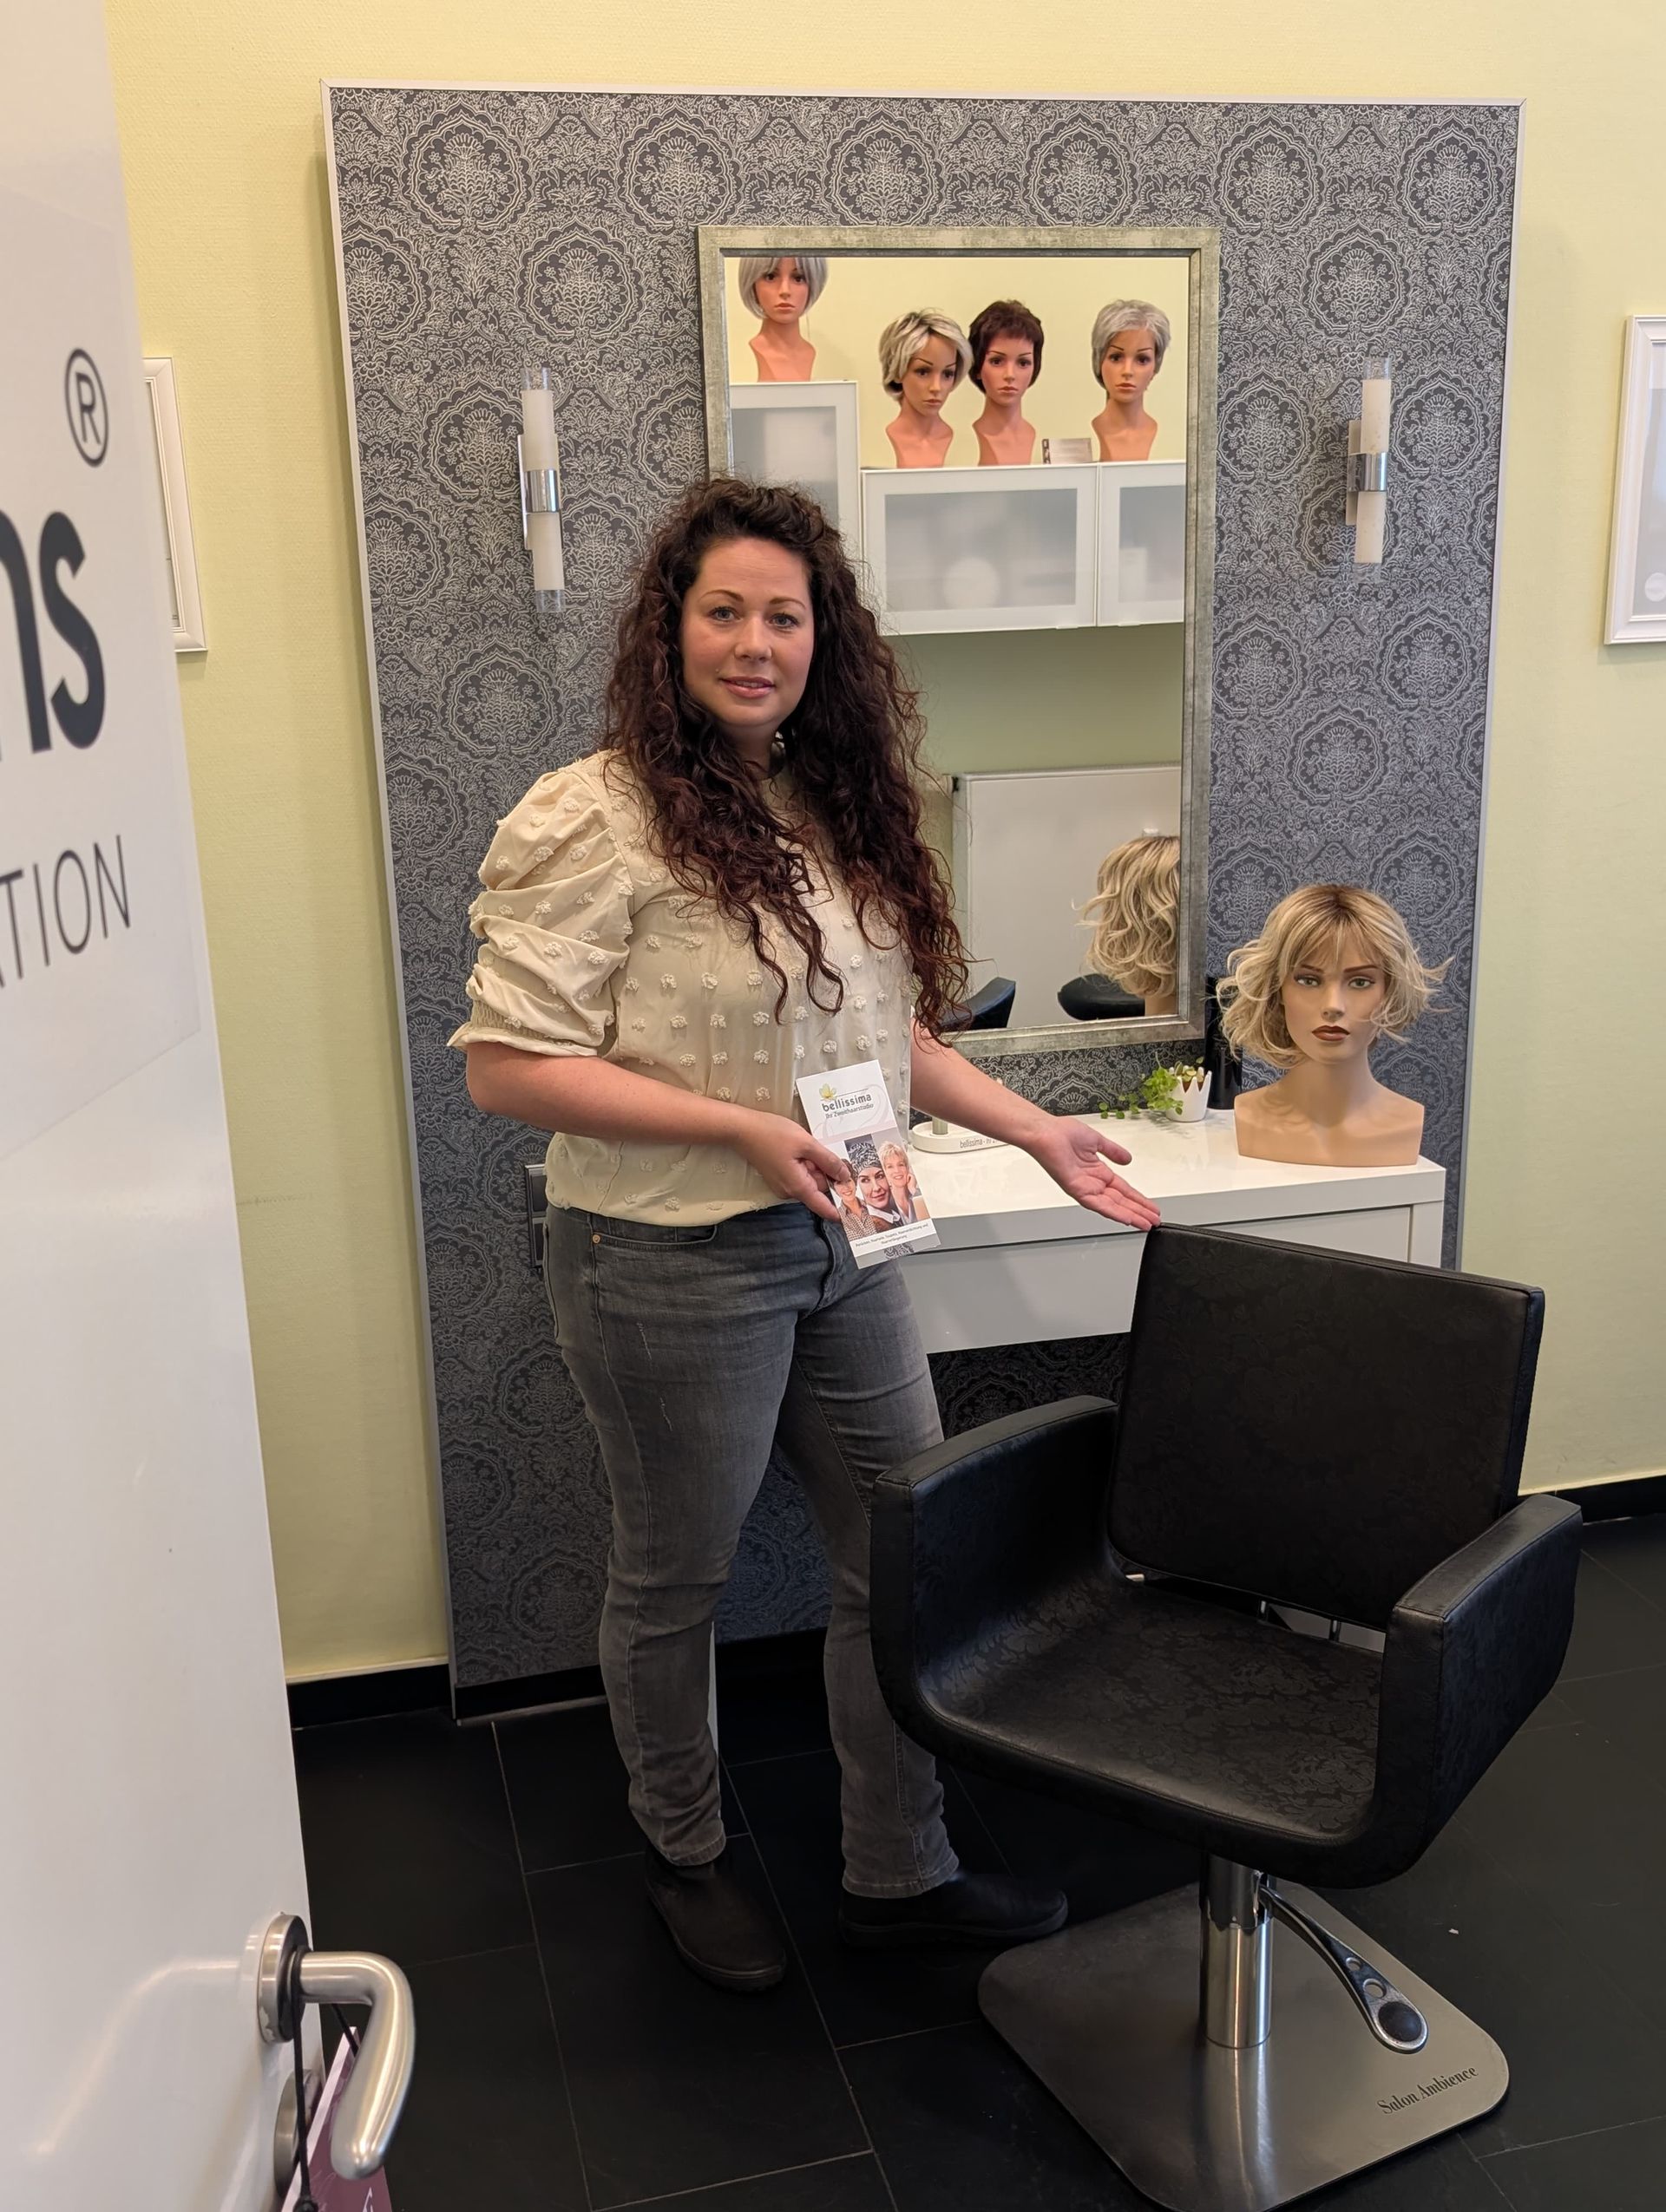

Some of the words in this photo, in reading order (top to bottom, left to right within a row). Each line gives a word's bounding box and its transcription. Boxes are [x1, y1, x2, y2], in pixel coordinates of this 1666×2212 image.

[0, 834, 131, 988] TION
[821, 1094, 872, 1112] bellissima
[1376, 2095, 1420, 2114] Salon
[1417, 2067, 1479, 2099] Ambience
